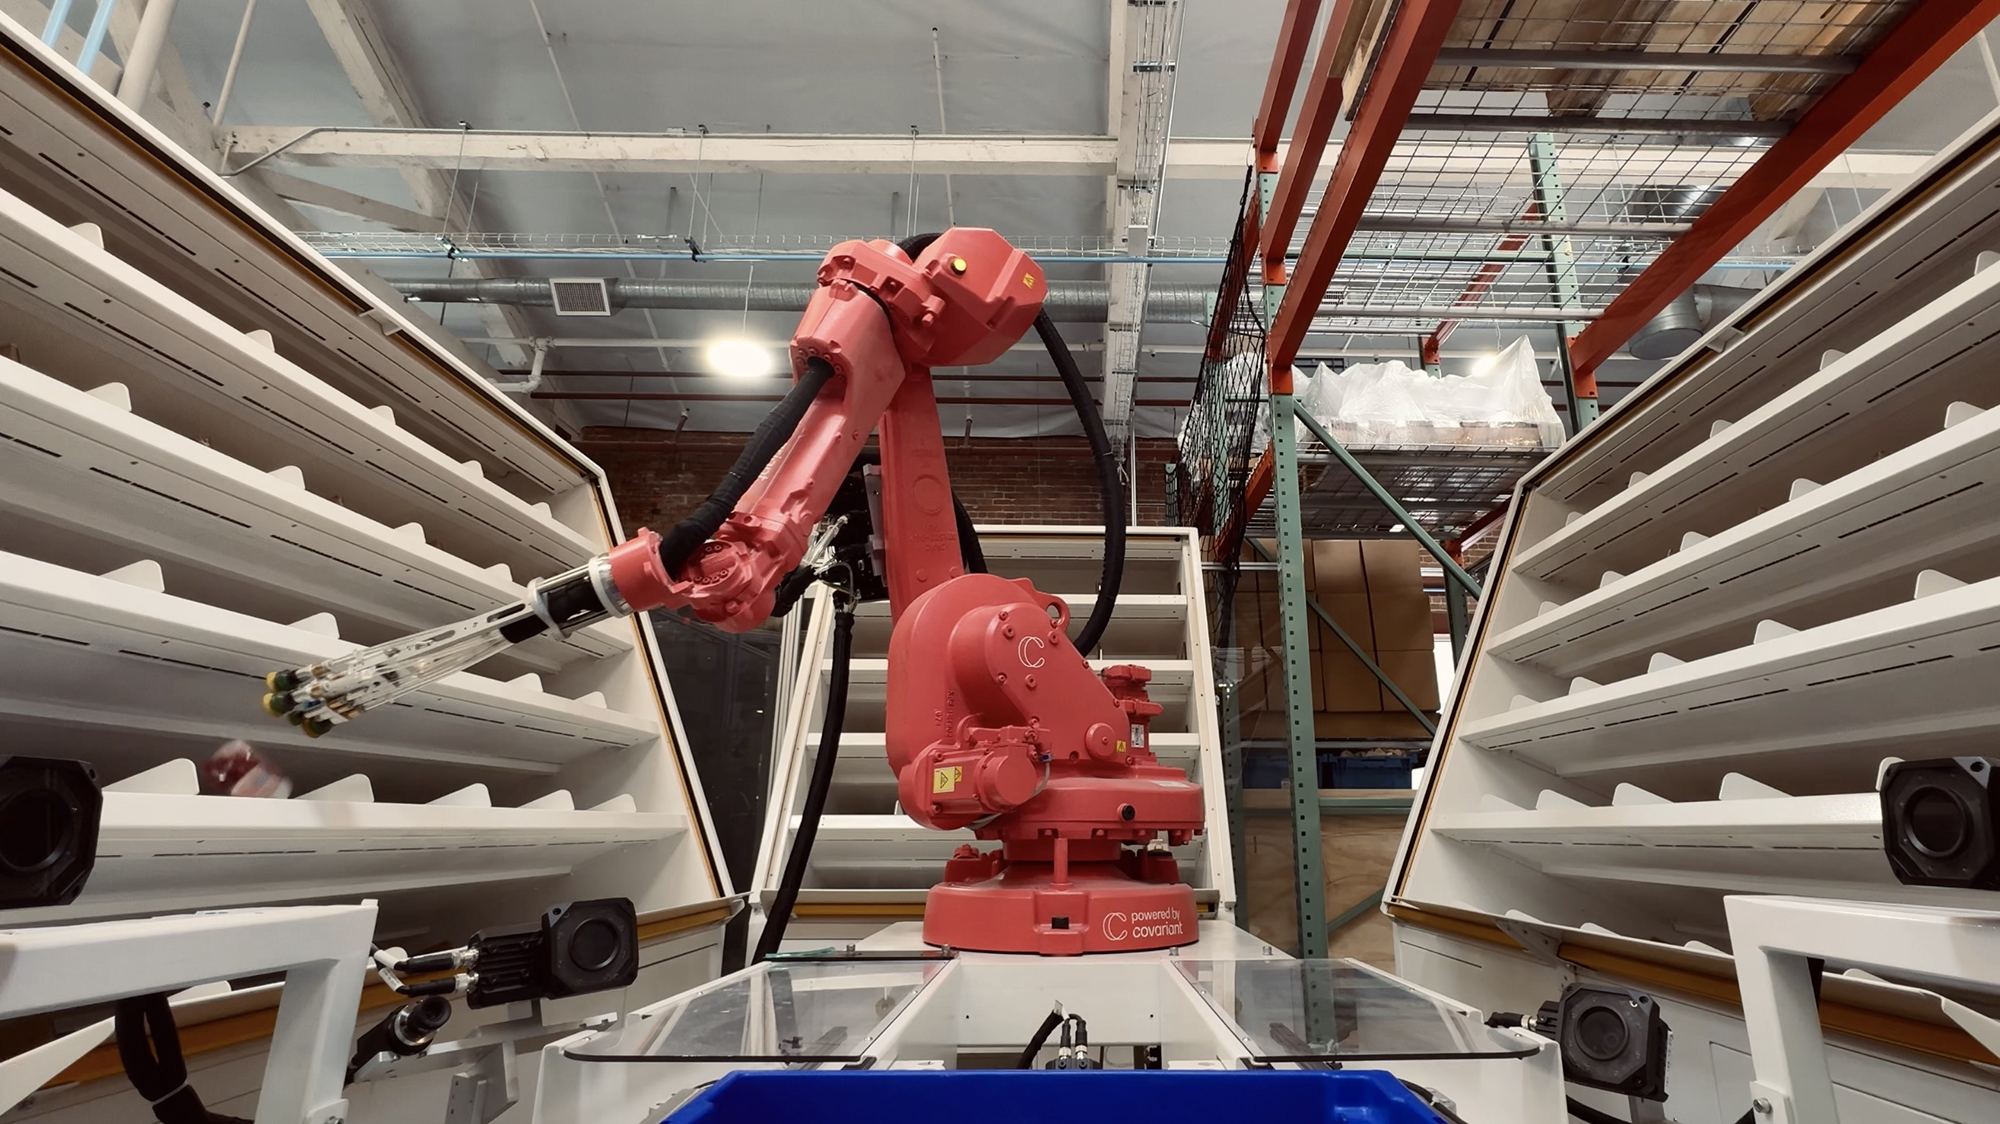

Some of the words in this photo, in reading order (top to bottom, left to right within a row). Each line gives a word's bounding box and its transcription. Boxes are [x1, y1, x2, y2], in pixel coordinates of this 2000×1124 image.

[1131, 907, 1171, 924] powered
[1171, 906, 1181, 922] by
[1132, 921, 1183, 938] covariant
